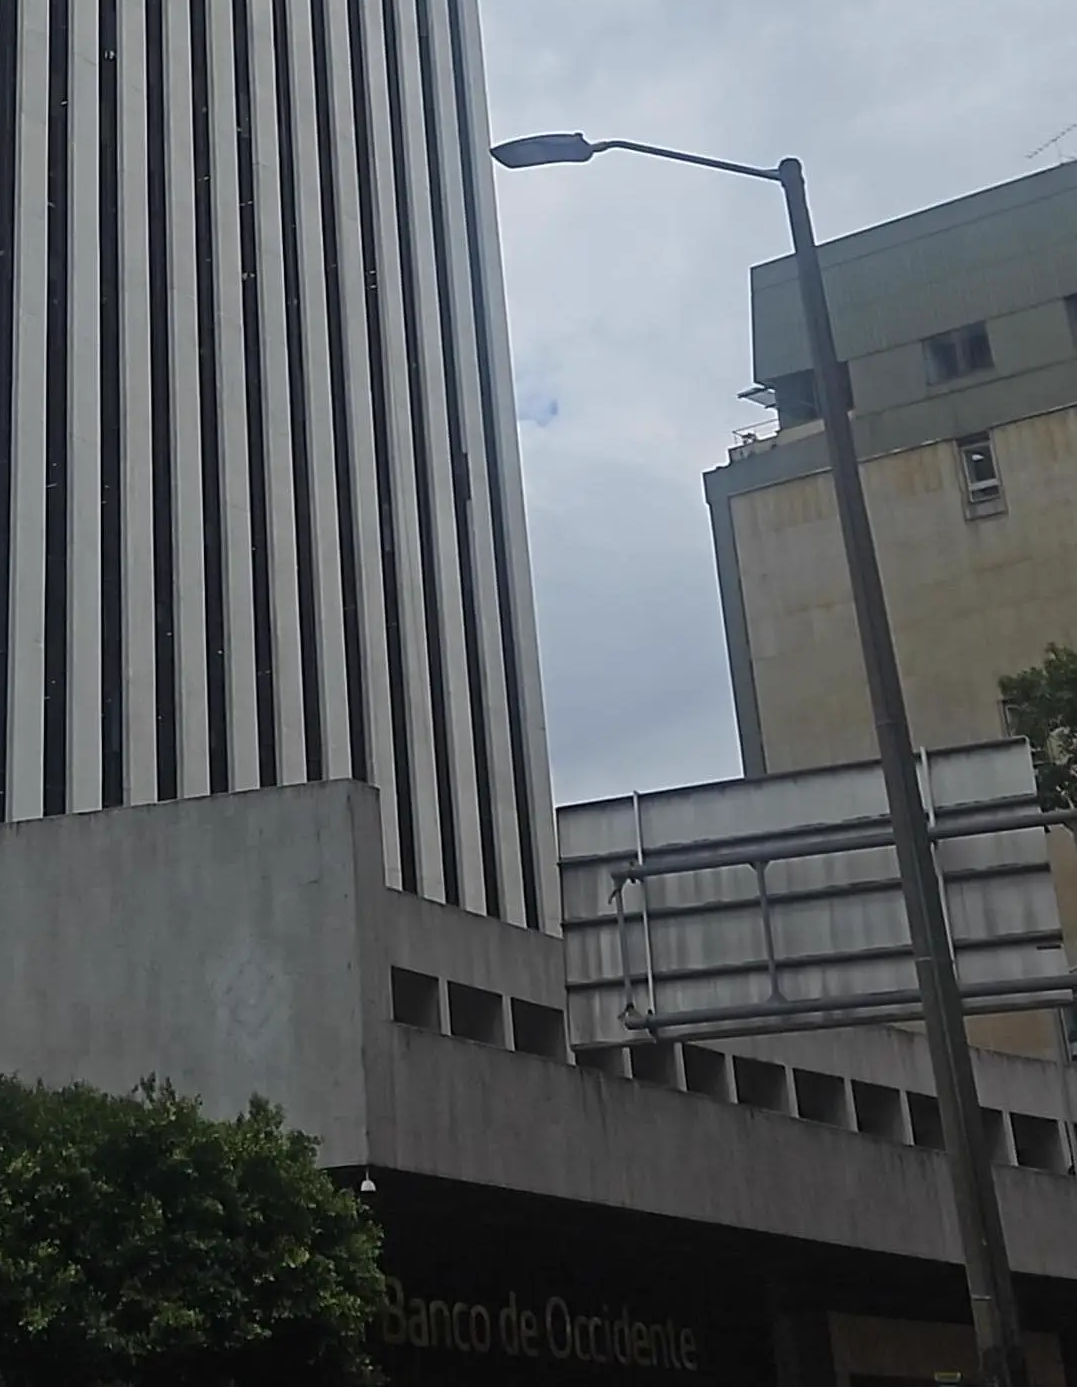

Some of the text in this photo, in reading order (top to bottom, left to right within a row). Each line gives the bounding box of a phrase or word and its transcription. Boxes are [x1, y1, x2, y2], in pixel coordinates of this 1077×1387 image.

[382, 1276, 699, 1371] Banco de Occidente
